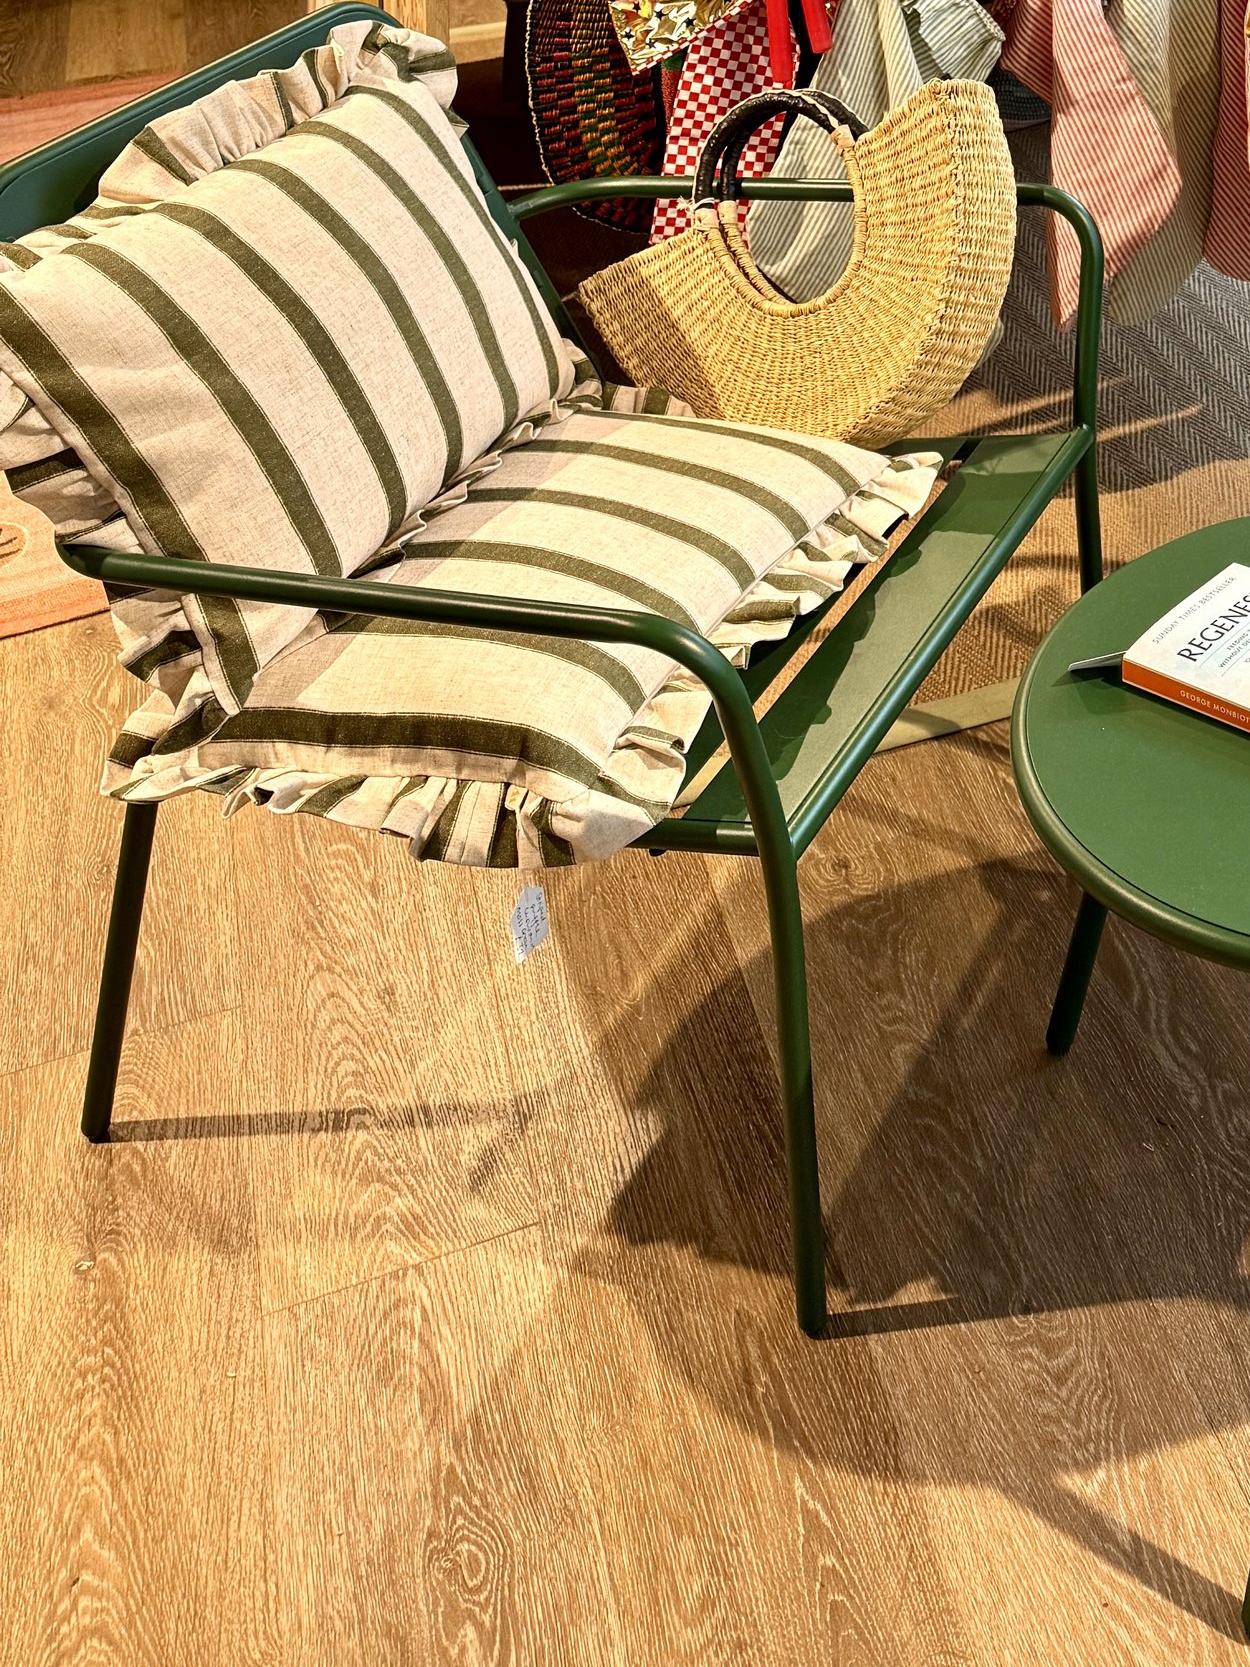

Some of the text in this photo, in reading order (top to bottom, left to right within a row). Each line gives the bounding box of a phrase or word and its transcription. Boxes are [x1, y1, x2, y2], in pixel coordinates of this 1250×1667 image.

[1152, 577, 1237, 644] SUNDAY TIMES BESTSELLER
[1227, 632, 1249, 651] FEEDING
[1219, 647, 1243, 668] WITHOUT
[1179, 689, 1211, 708] GEORGE
[1212, 702, 1250, 724] MONBIOT
